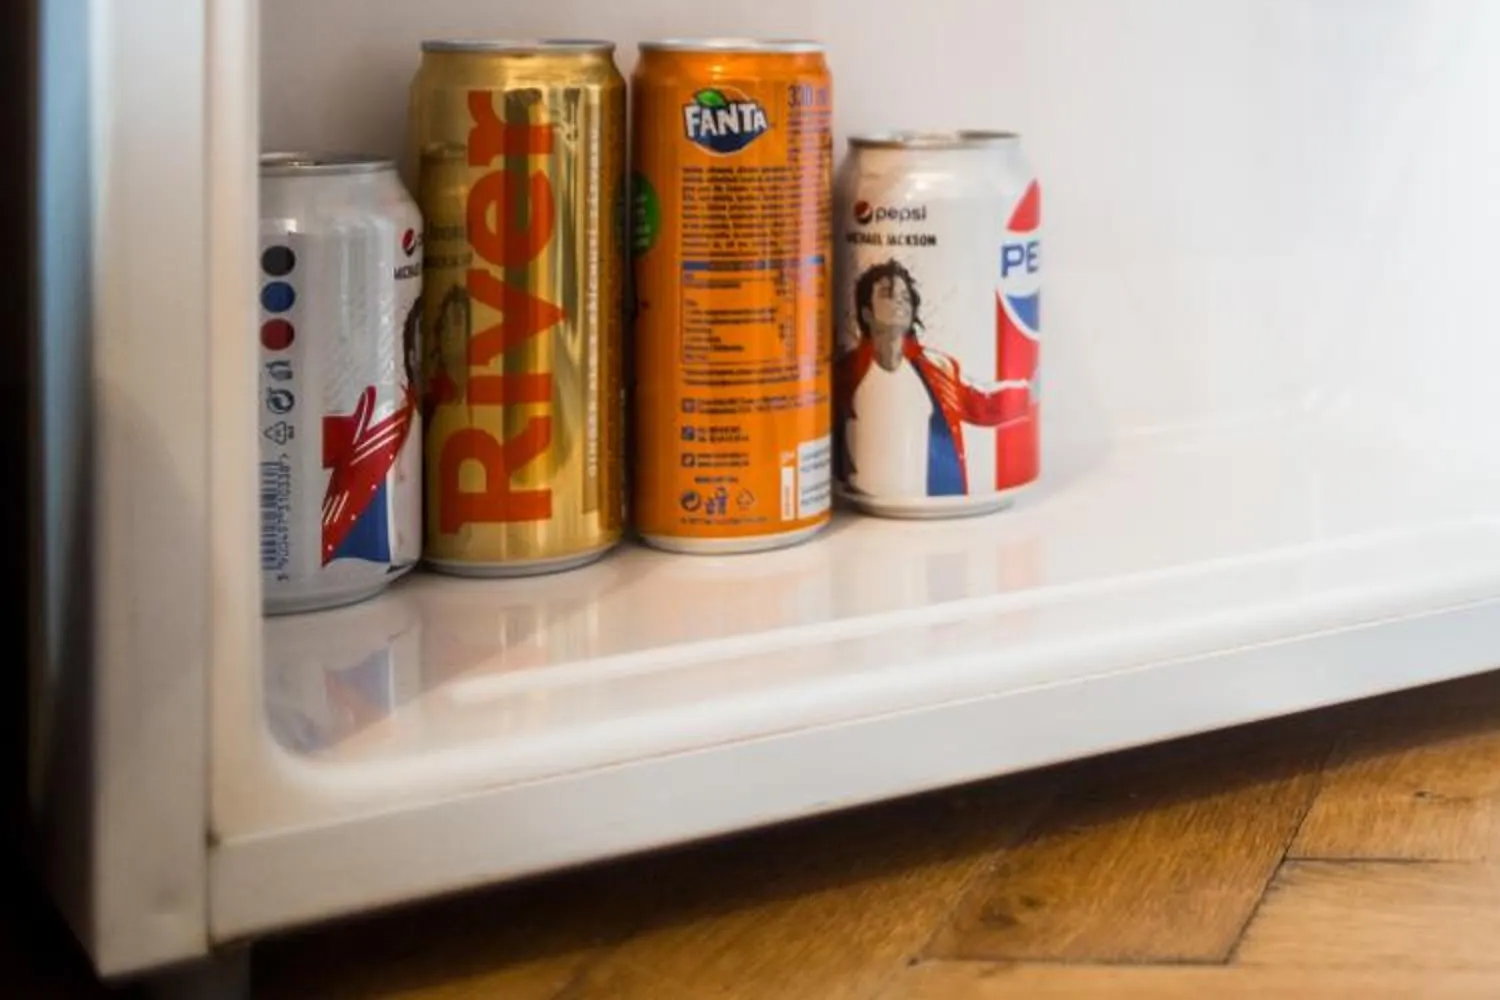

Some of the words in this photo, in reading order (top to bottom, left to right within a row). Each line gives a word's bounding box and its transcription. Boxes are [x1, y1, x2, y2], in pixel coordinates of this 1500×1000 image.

[684, 102, 767, 139] FANTA
[875, 204, 927, 224] pepsi
[887, 233, 937, 246] JACKSON
[440, 90, 567, 534] River
